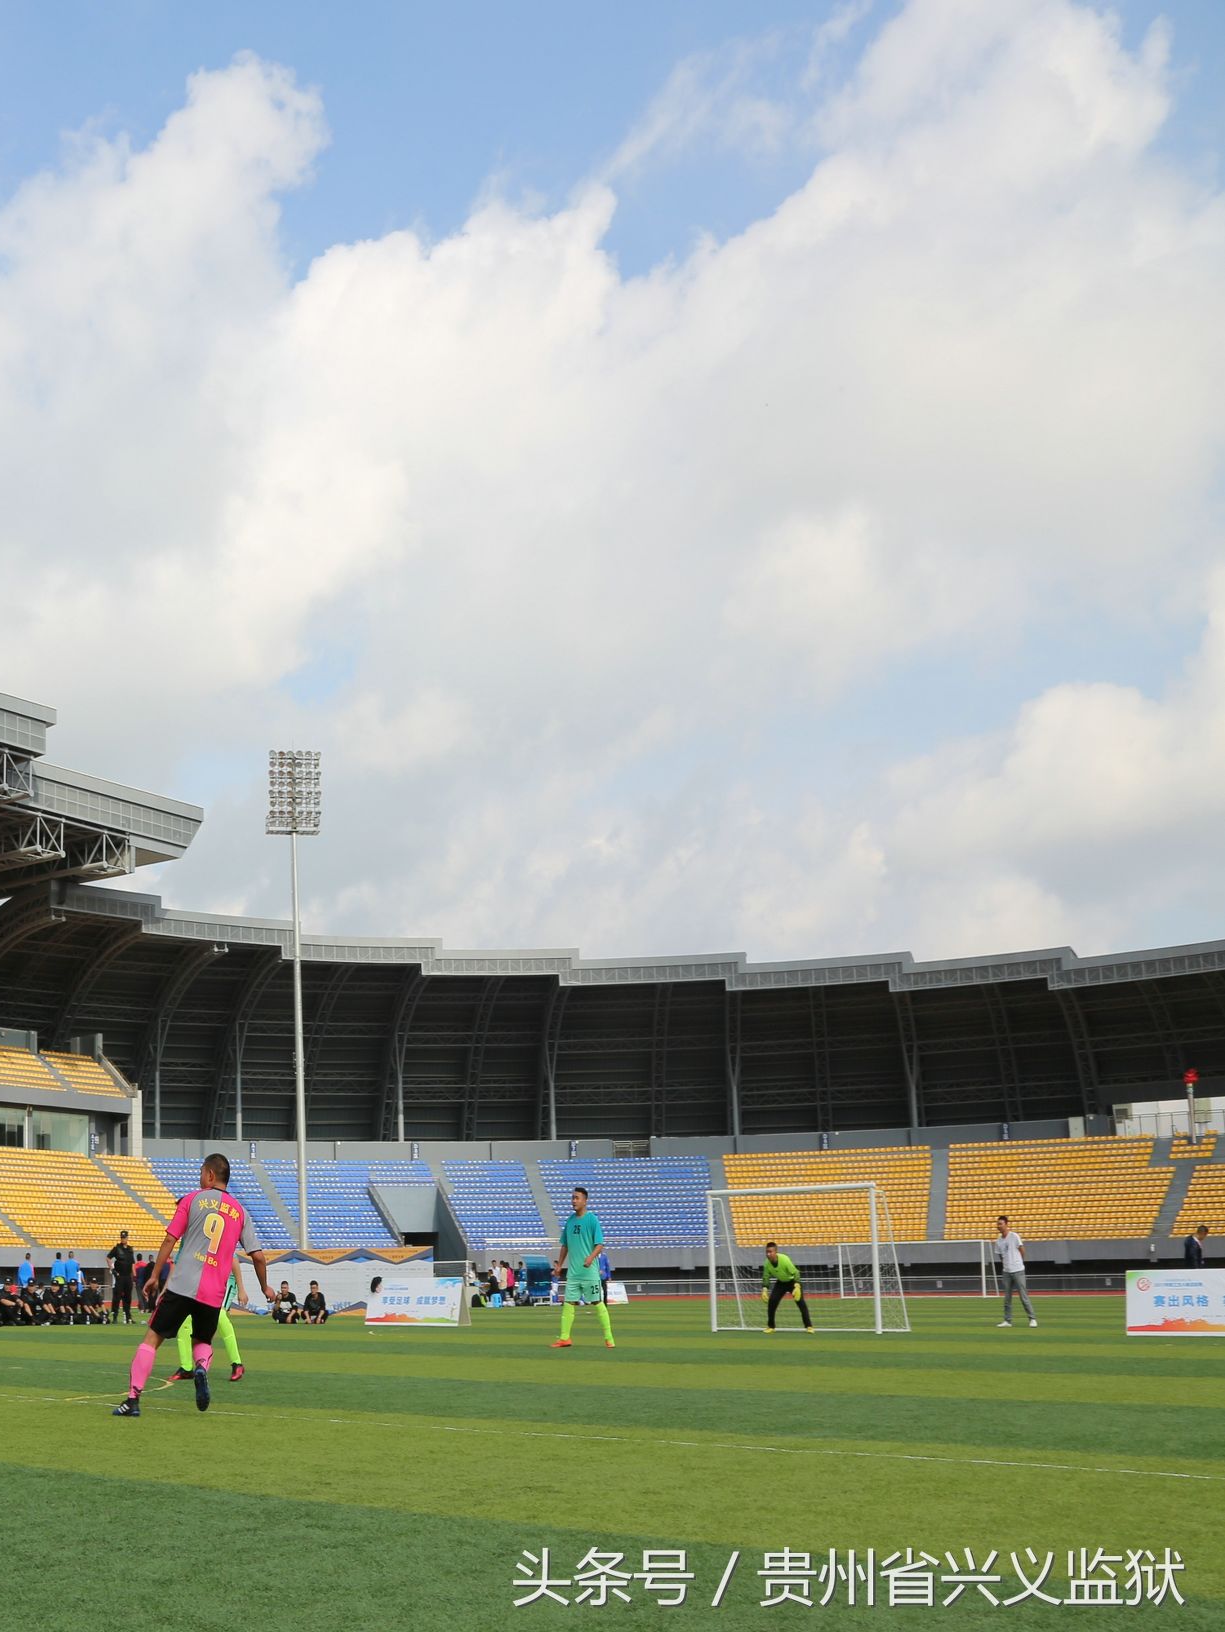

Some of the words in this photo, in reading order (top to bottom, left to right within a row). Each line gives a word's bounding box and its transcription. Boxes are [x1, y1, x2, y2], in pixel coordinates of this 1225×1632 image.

[199, 1198, 240, 1221] 兴义监狱
[203, 1213, 225, 1254] 9
[573, 1225, 581, 1235] 25
[590, 1284, 600, 1295] 25
[1153, 1295, 1209, 1308] 赛出风格
